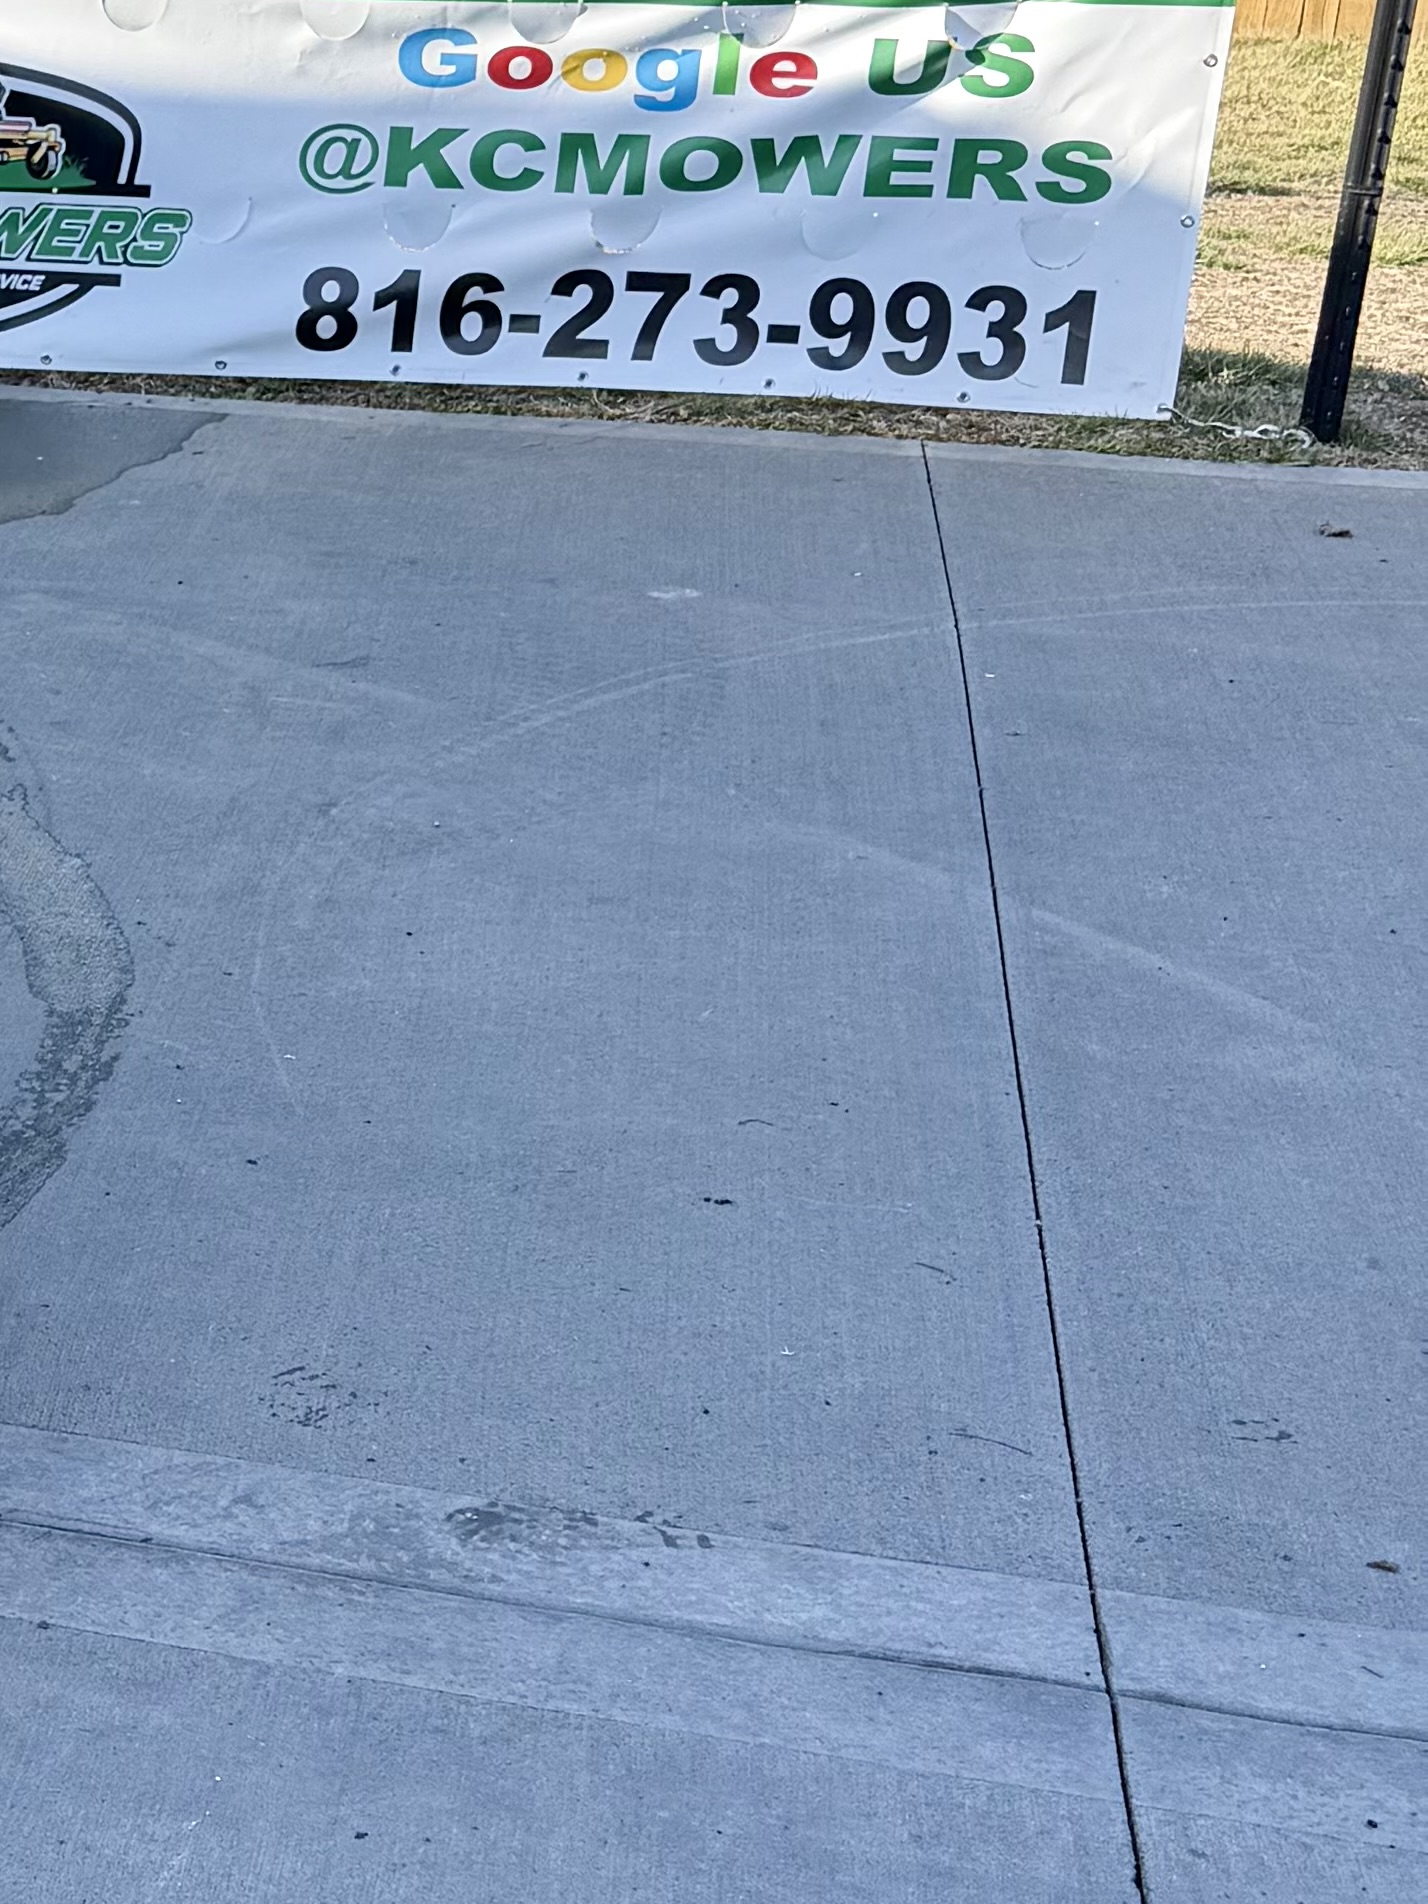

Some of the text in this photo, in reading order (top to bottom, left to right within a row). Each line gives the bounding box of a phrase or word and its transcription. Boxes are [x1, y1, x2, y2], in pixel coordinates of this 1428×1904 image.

[397, 27, 1036, 113] Google US
[297, 122, 1114, 206] @KCMOWERS
[294, 266, 1098, 386] 816-273-9931
